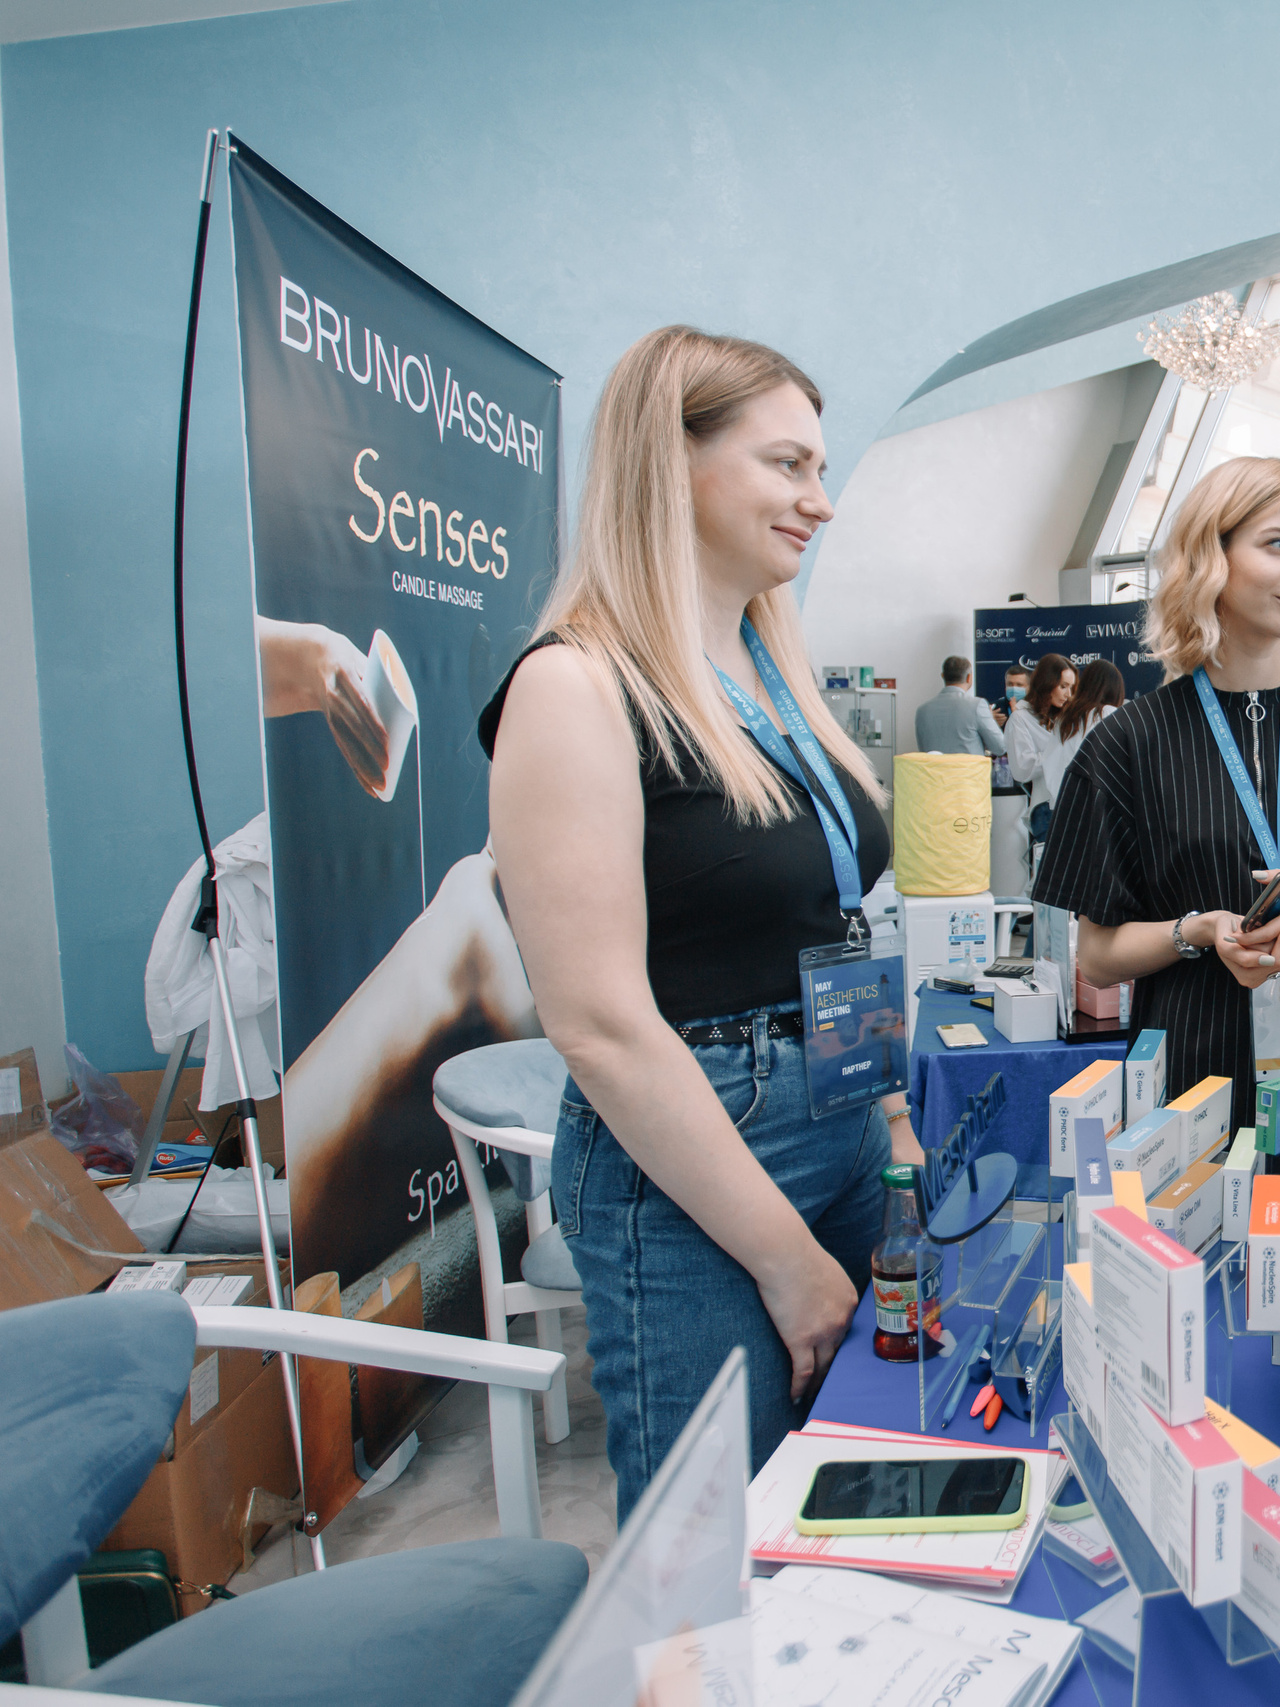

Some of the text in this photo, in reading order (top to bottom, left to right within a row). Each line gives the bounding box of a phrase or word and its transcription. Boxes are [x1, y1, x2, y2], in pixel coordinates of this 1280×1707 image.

[349, 448, 510, 580] Senses
[392, 570, 484, 612] CANDLE MASSAGE
[1097, 621, 1138, 637] VIVACY
[779, 689, 808, 734] EURO ESTET
[1228, 746, 1248, 784] EURO ESTET
[815, 981, 832, 993] MAY
[816, 984, 879, 1010] AESTHETICS
[817, 1004, 850, 1020] MEETING
[842, 1060, 872, 1076] ПАРТНЕР
[158, 1153, 174, 1163] Ruta
[408, 1160, 459, 1239] Spa
[1268, 1260, 1276, 1304] NucleoSpire
